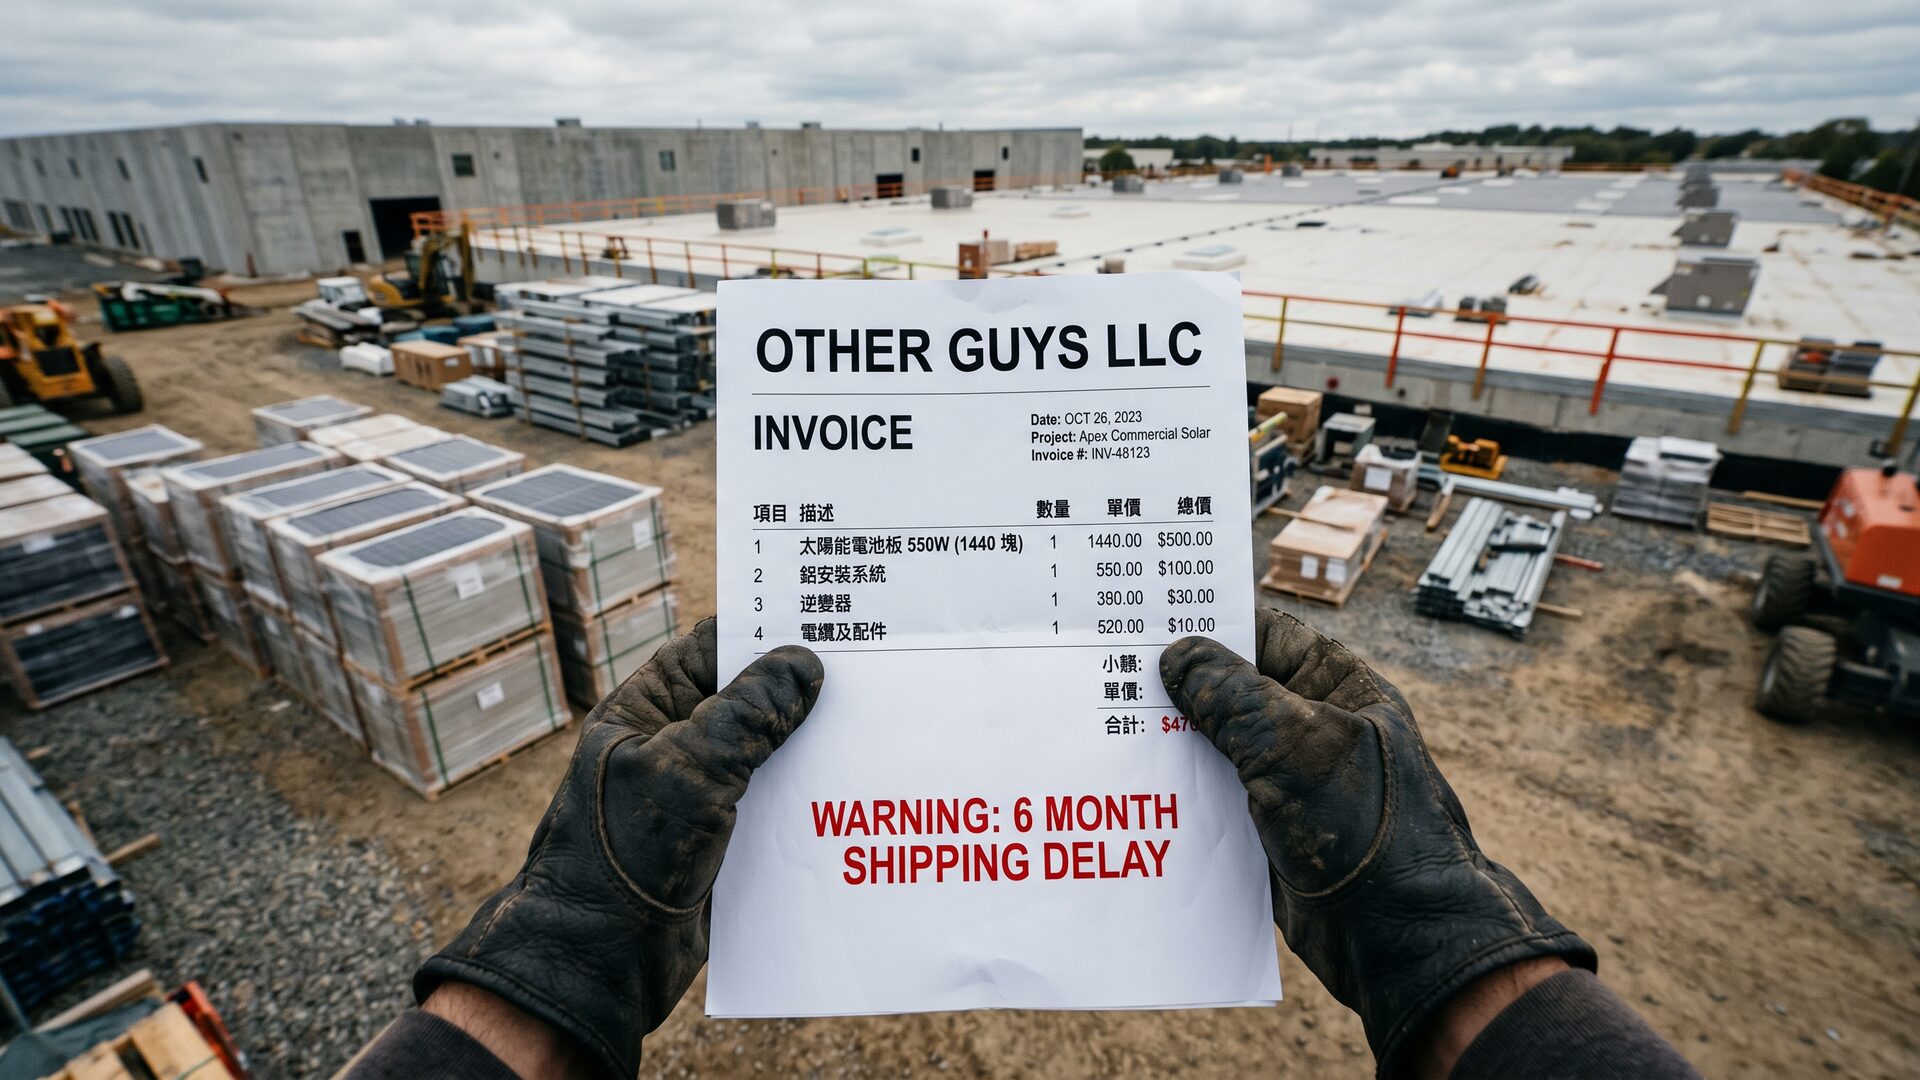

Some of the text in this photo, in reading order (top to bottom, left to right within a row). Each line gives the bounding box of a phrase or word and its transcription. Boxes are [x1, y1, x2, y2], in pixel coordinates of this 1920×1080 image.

[756, 321, 1203, 373] OTHER GUYS LLC
[1030, 410, 1142, 426] Date: OCT 26, 2023
[754, 414, 914, 451] INVOICE
[1031, 426, 1211, 446] Project: Apex Commercial Solar
[1031, 446, 1151, 461] Invoice #: INV-48123
[753, 496, 1212, 523] 項目 描述 數量 單價 總價
[754, 531, 1213, 556] 1 太陽能電池板 550W (1440 塊) 1 1440.00 $500.00
[754, 559, 1214, 585] 2 鋁安裝系統 1 550.00 $100.00
[754, 588, 1215, 614] 3 逆變器 1 380.00 $30.00
[754, 626, 763, 640] 4
[1052, 620, 1058, 635] 1
[1097, 619, 1144, 634] 520.00
[1168, 617, 1215, 634] $10.00
[1104, 681, 1143, 701] 單價:
[1105, 715, 1145, 735] 合計:
[811, 793, 1179, 837] WARNING: 6 MONTH
[842, 839, 1171, 885] SHIPPING DELAY
